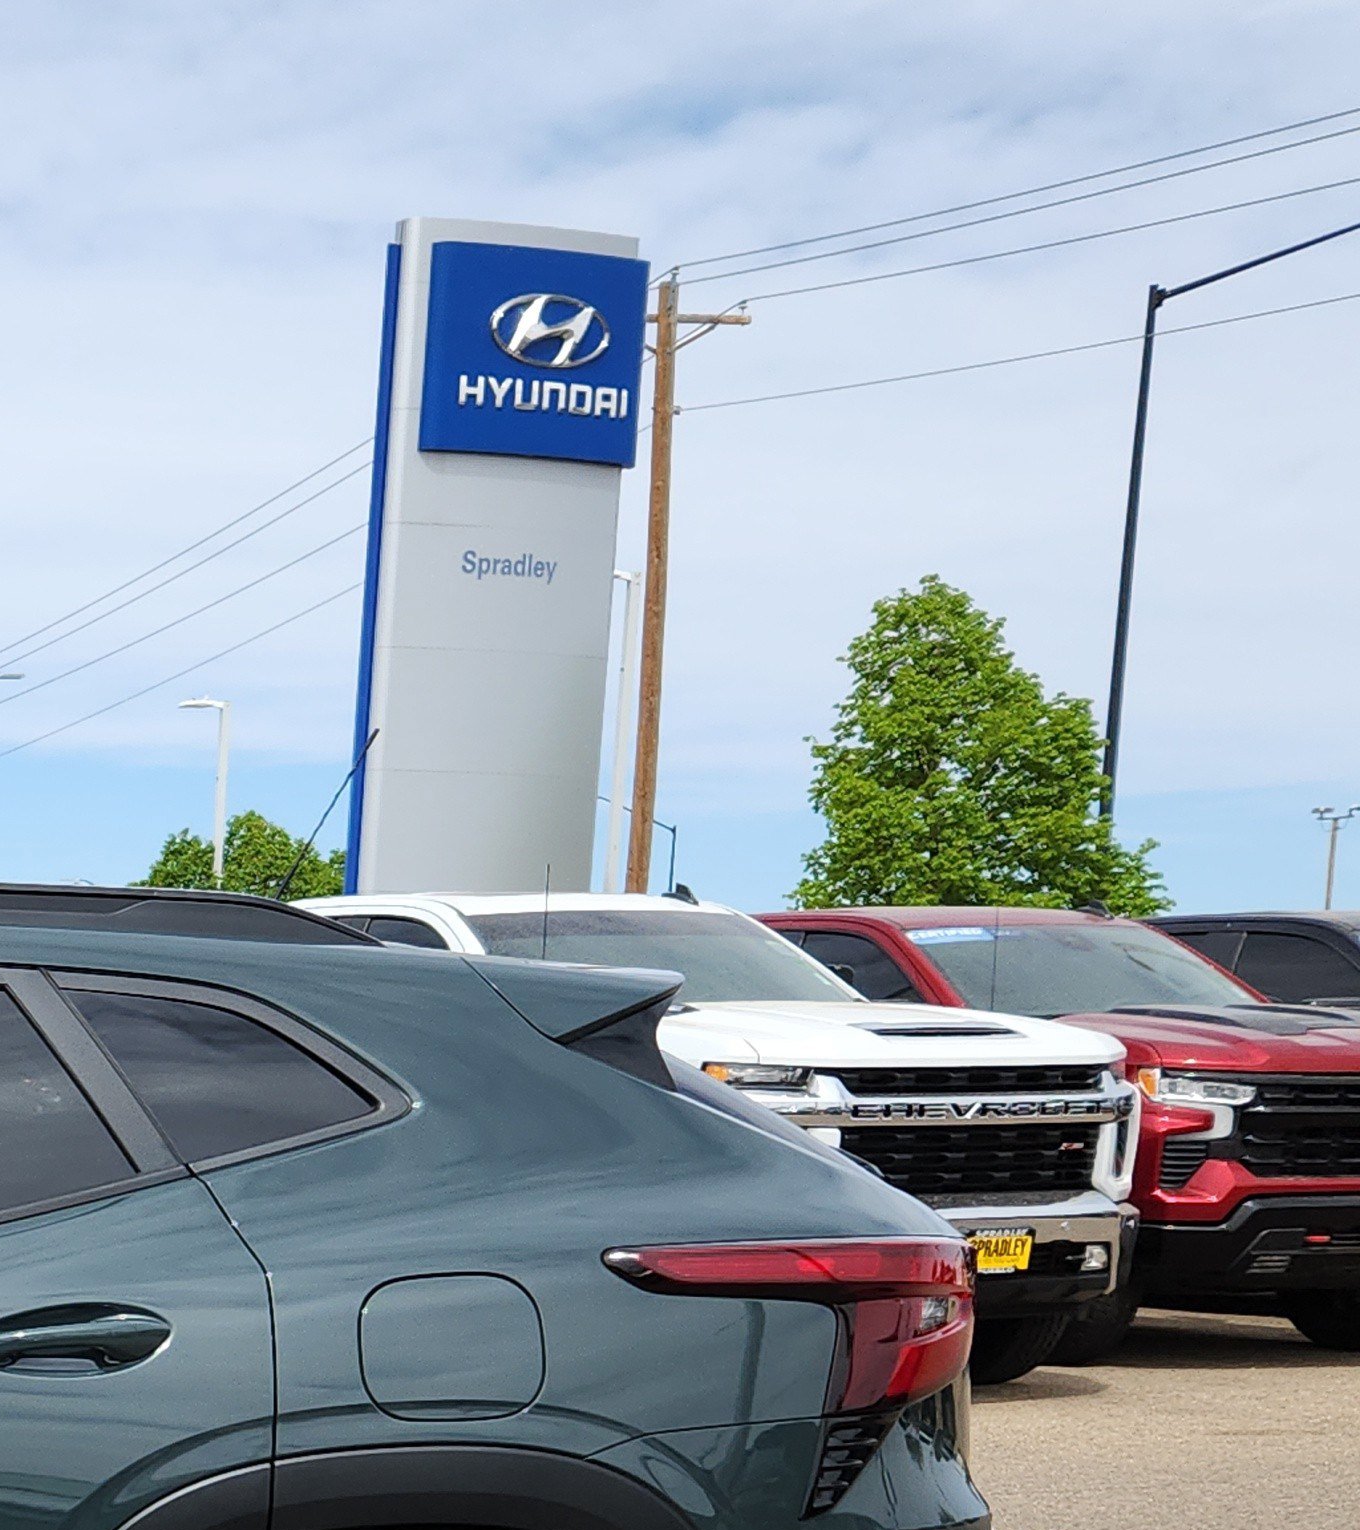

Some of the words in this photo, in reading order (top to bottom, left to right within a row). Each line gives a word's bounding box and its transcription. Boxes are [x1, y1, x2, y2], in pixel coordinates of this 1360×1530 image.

[458, 374, 629, 419] HYUNDAI
[461, 550, 557, 585] Spradley
[849, 1099, 1104, 1120] CHEVROLET
